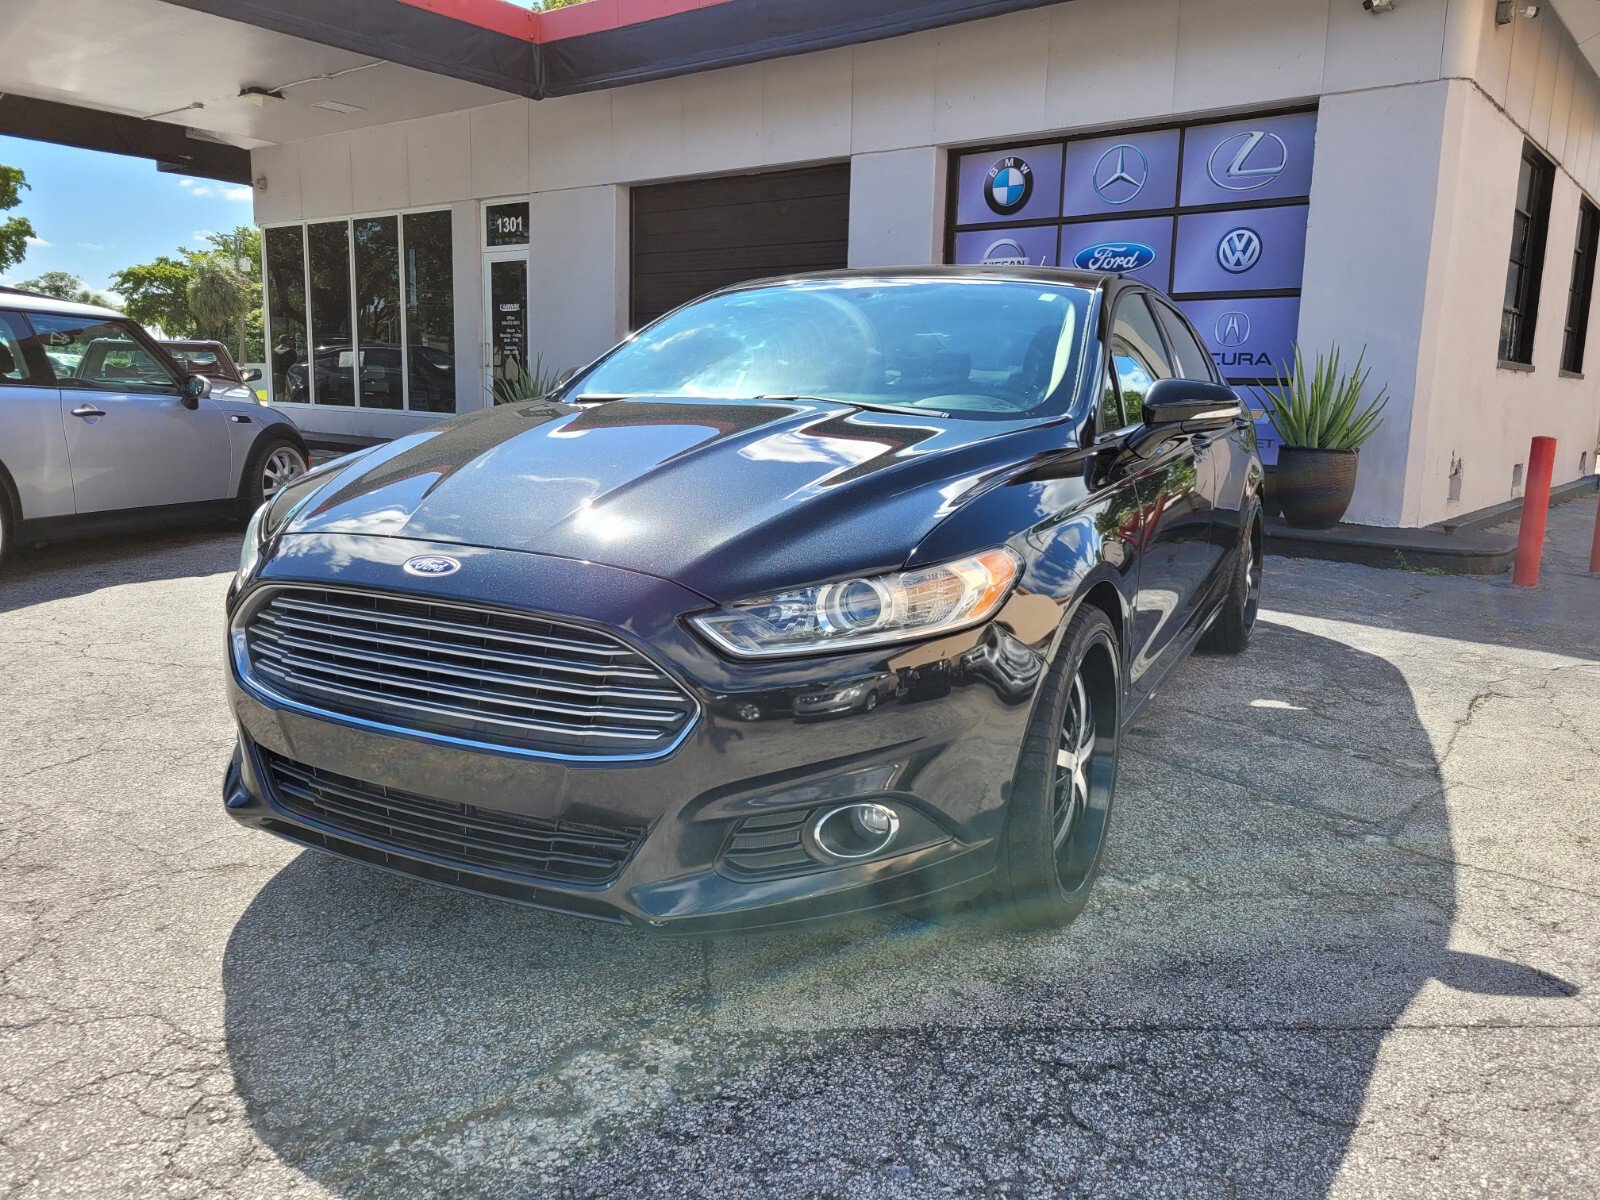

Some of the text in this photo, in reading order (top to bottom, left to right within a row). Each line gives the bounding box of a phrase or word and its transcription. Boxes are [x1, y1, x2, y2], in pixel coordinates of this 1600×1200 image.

[989, 158, 1031, 178] BMW
[497, 216, 522, 233] 1301
[1088, 246, 1140, 270] Ford
[1211, 352, 1272, 366] CURA
[414, 560, 449, 572] Ford
